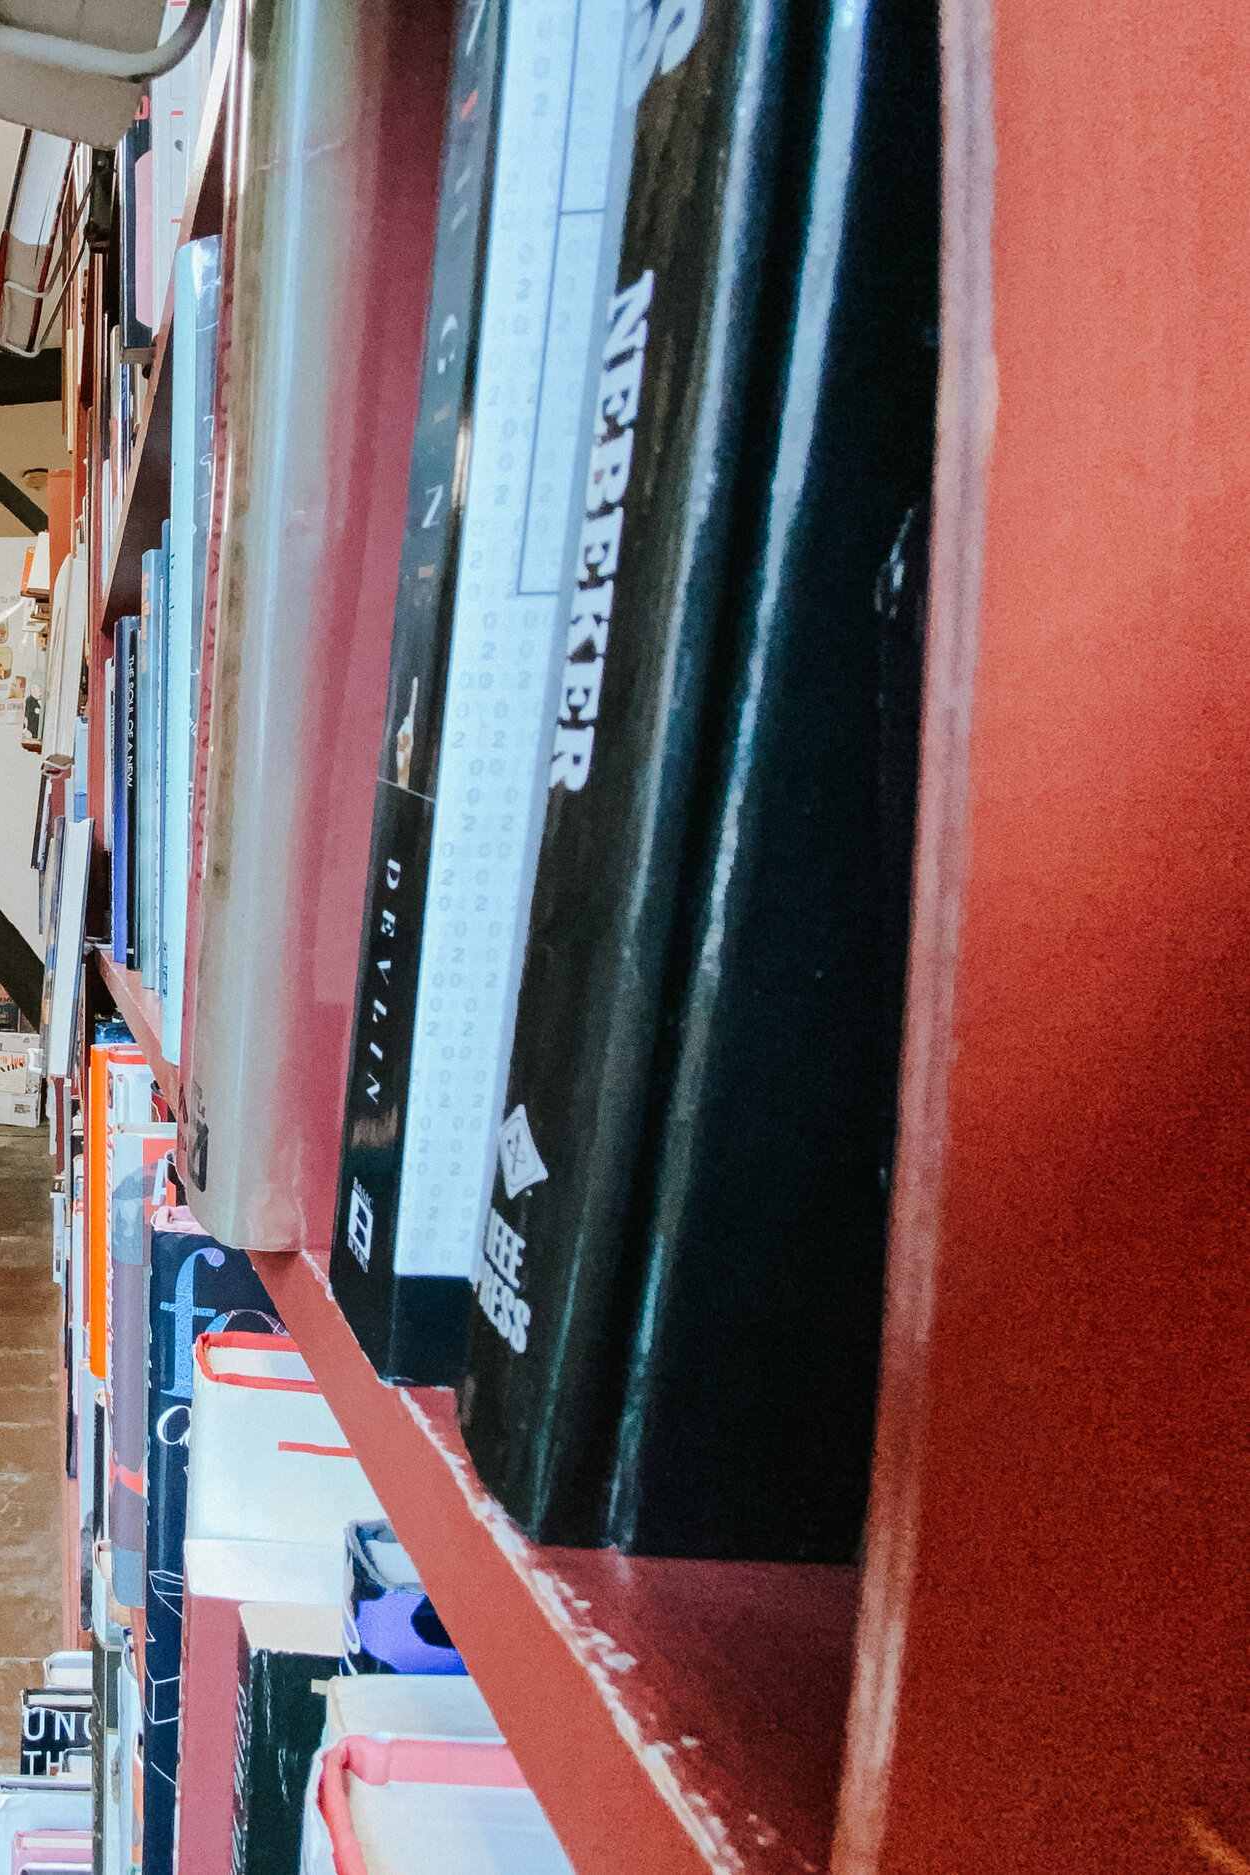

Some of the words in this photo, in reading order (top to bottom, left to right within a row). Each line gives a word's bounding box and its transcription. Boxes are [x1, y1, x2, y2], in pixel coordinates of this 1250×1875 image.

[550, 269, 656, 794] NEBEKER
[366, 857, 403, 1105] DEVLIN
[484, 1206, 527, 1289] IEEE
